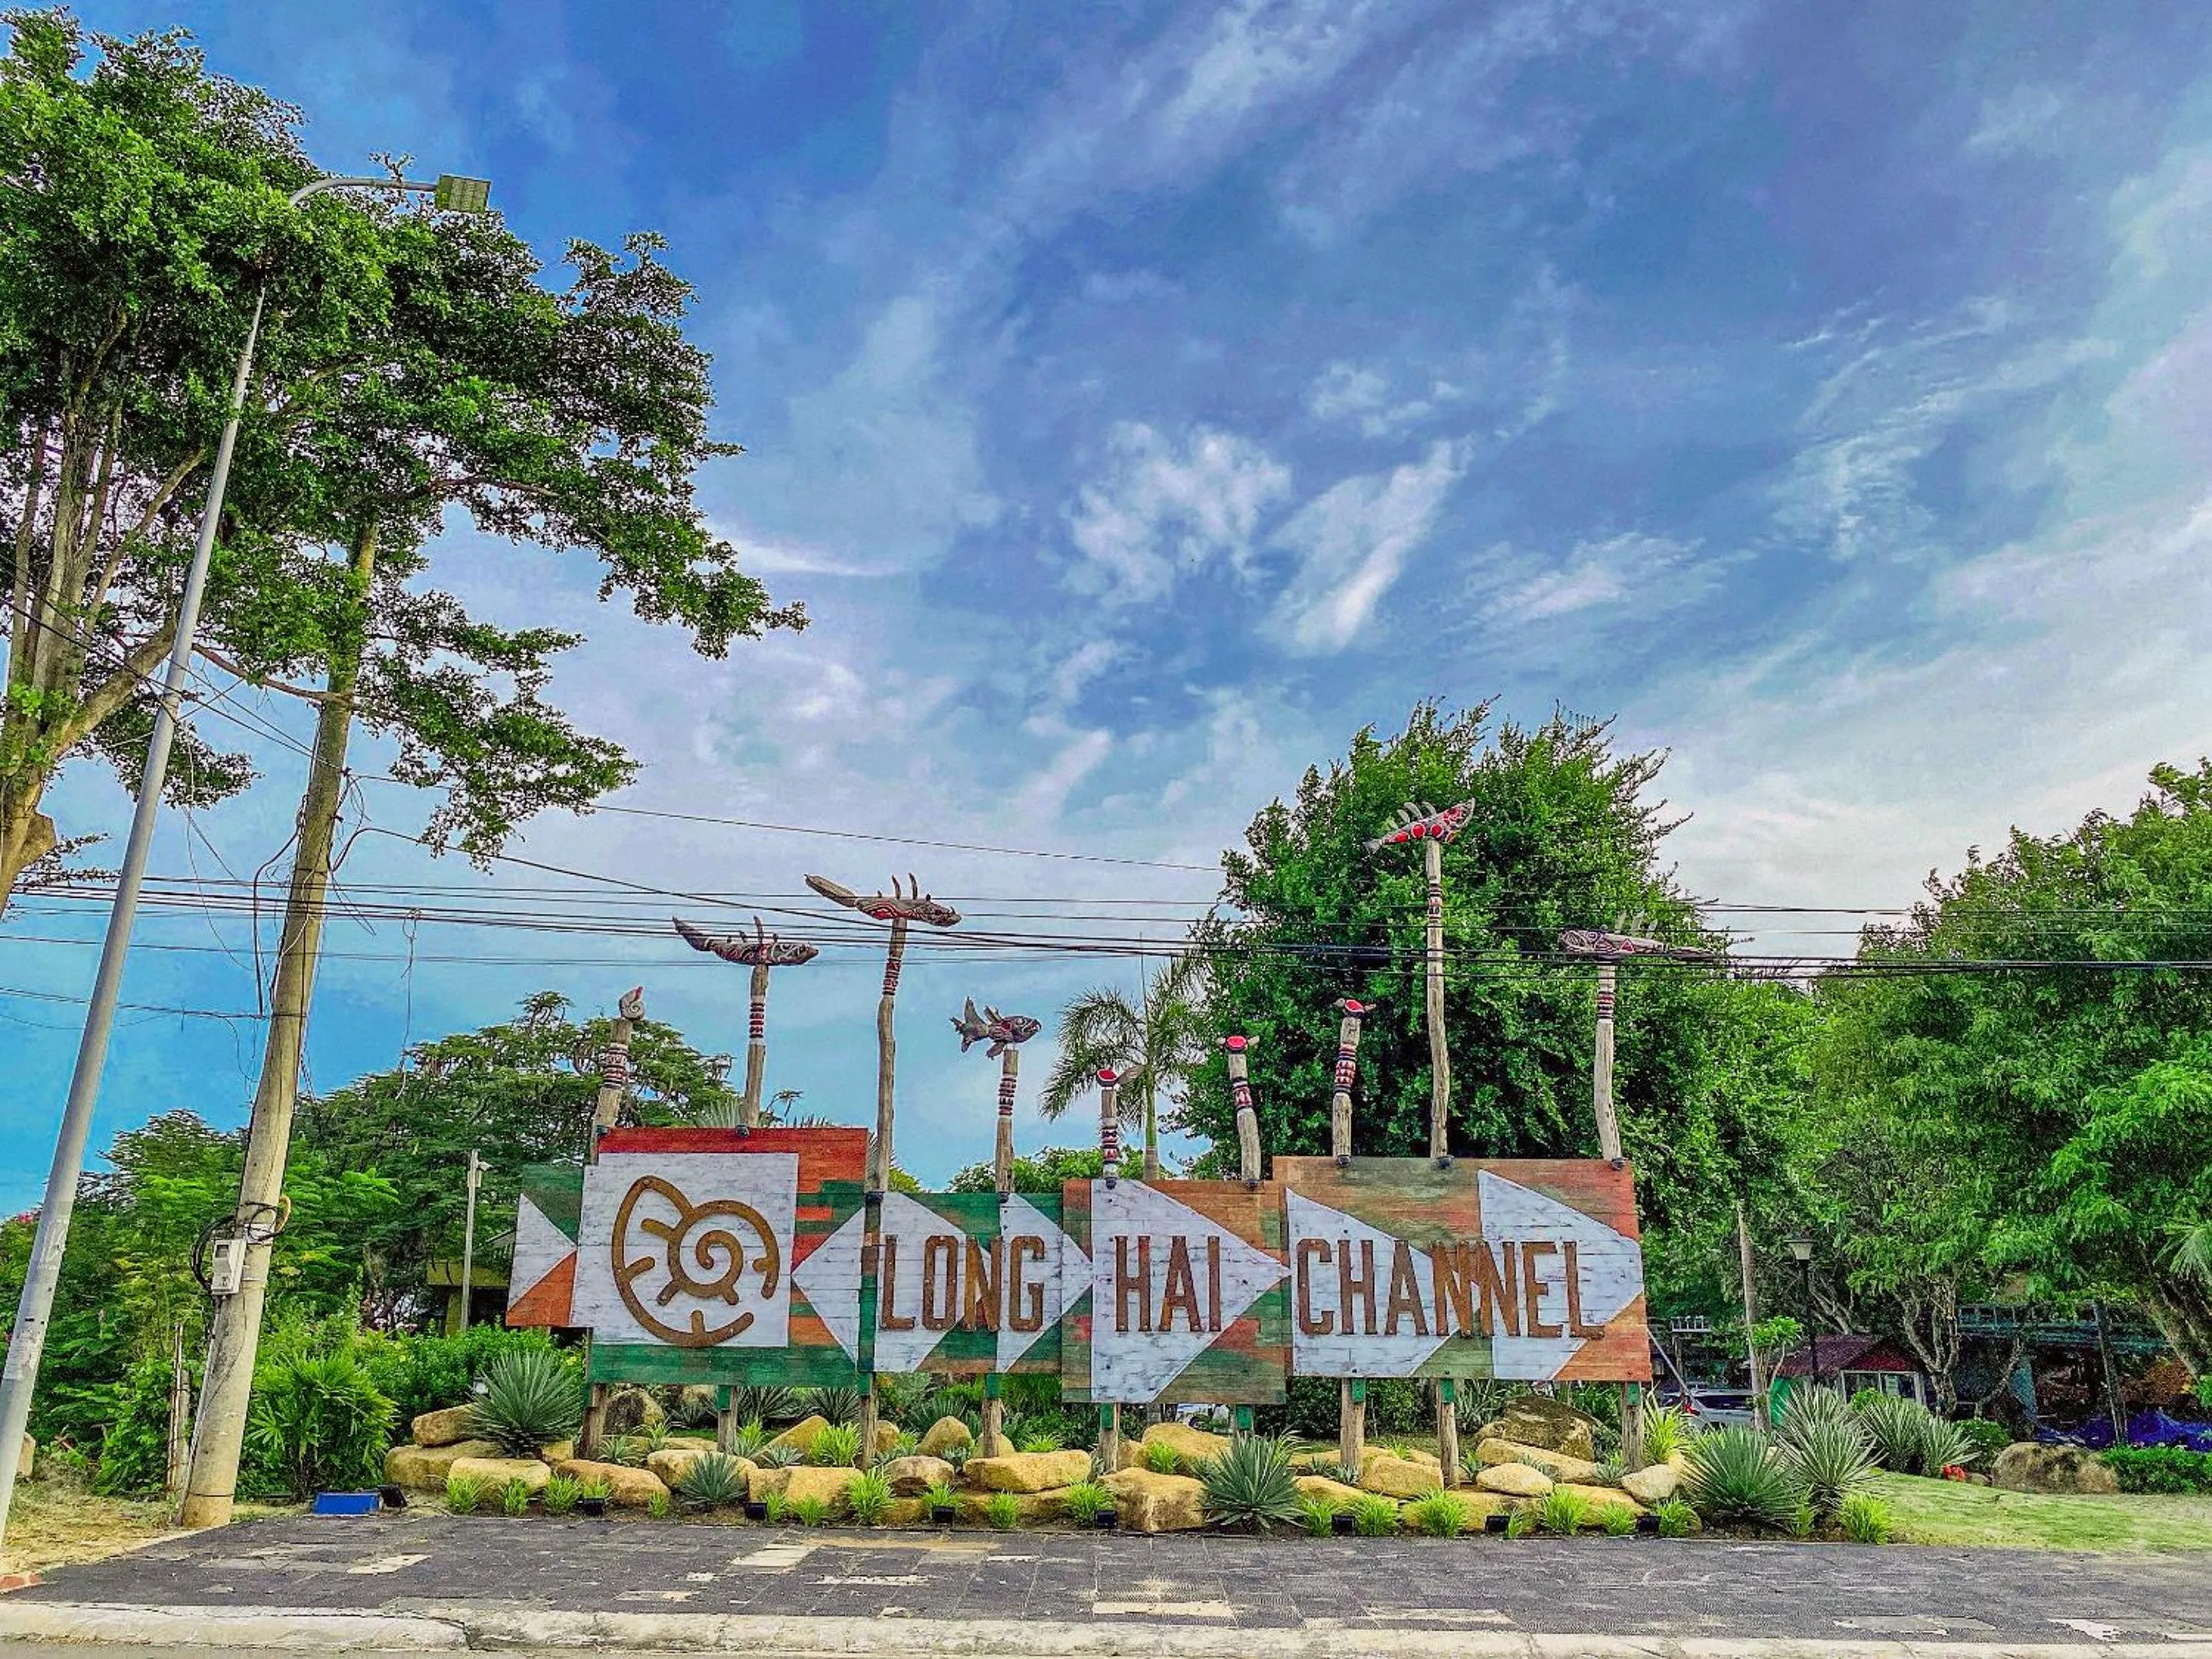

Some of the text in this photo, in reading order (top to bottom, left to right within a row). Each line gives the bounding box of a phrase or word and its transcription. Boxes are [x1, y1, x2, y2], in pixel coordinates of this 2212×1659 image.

[880, 1234, 1606, 1339] LONG HAI CHANNEL
